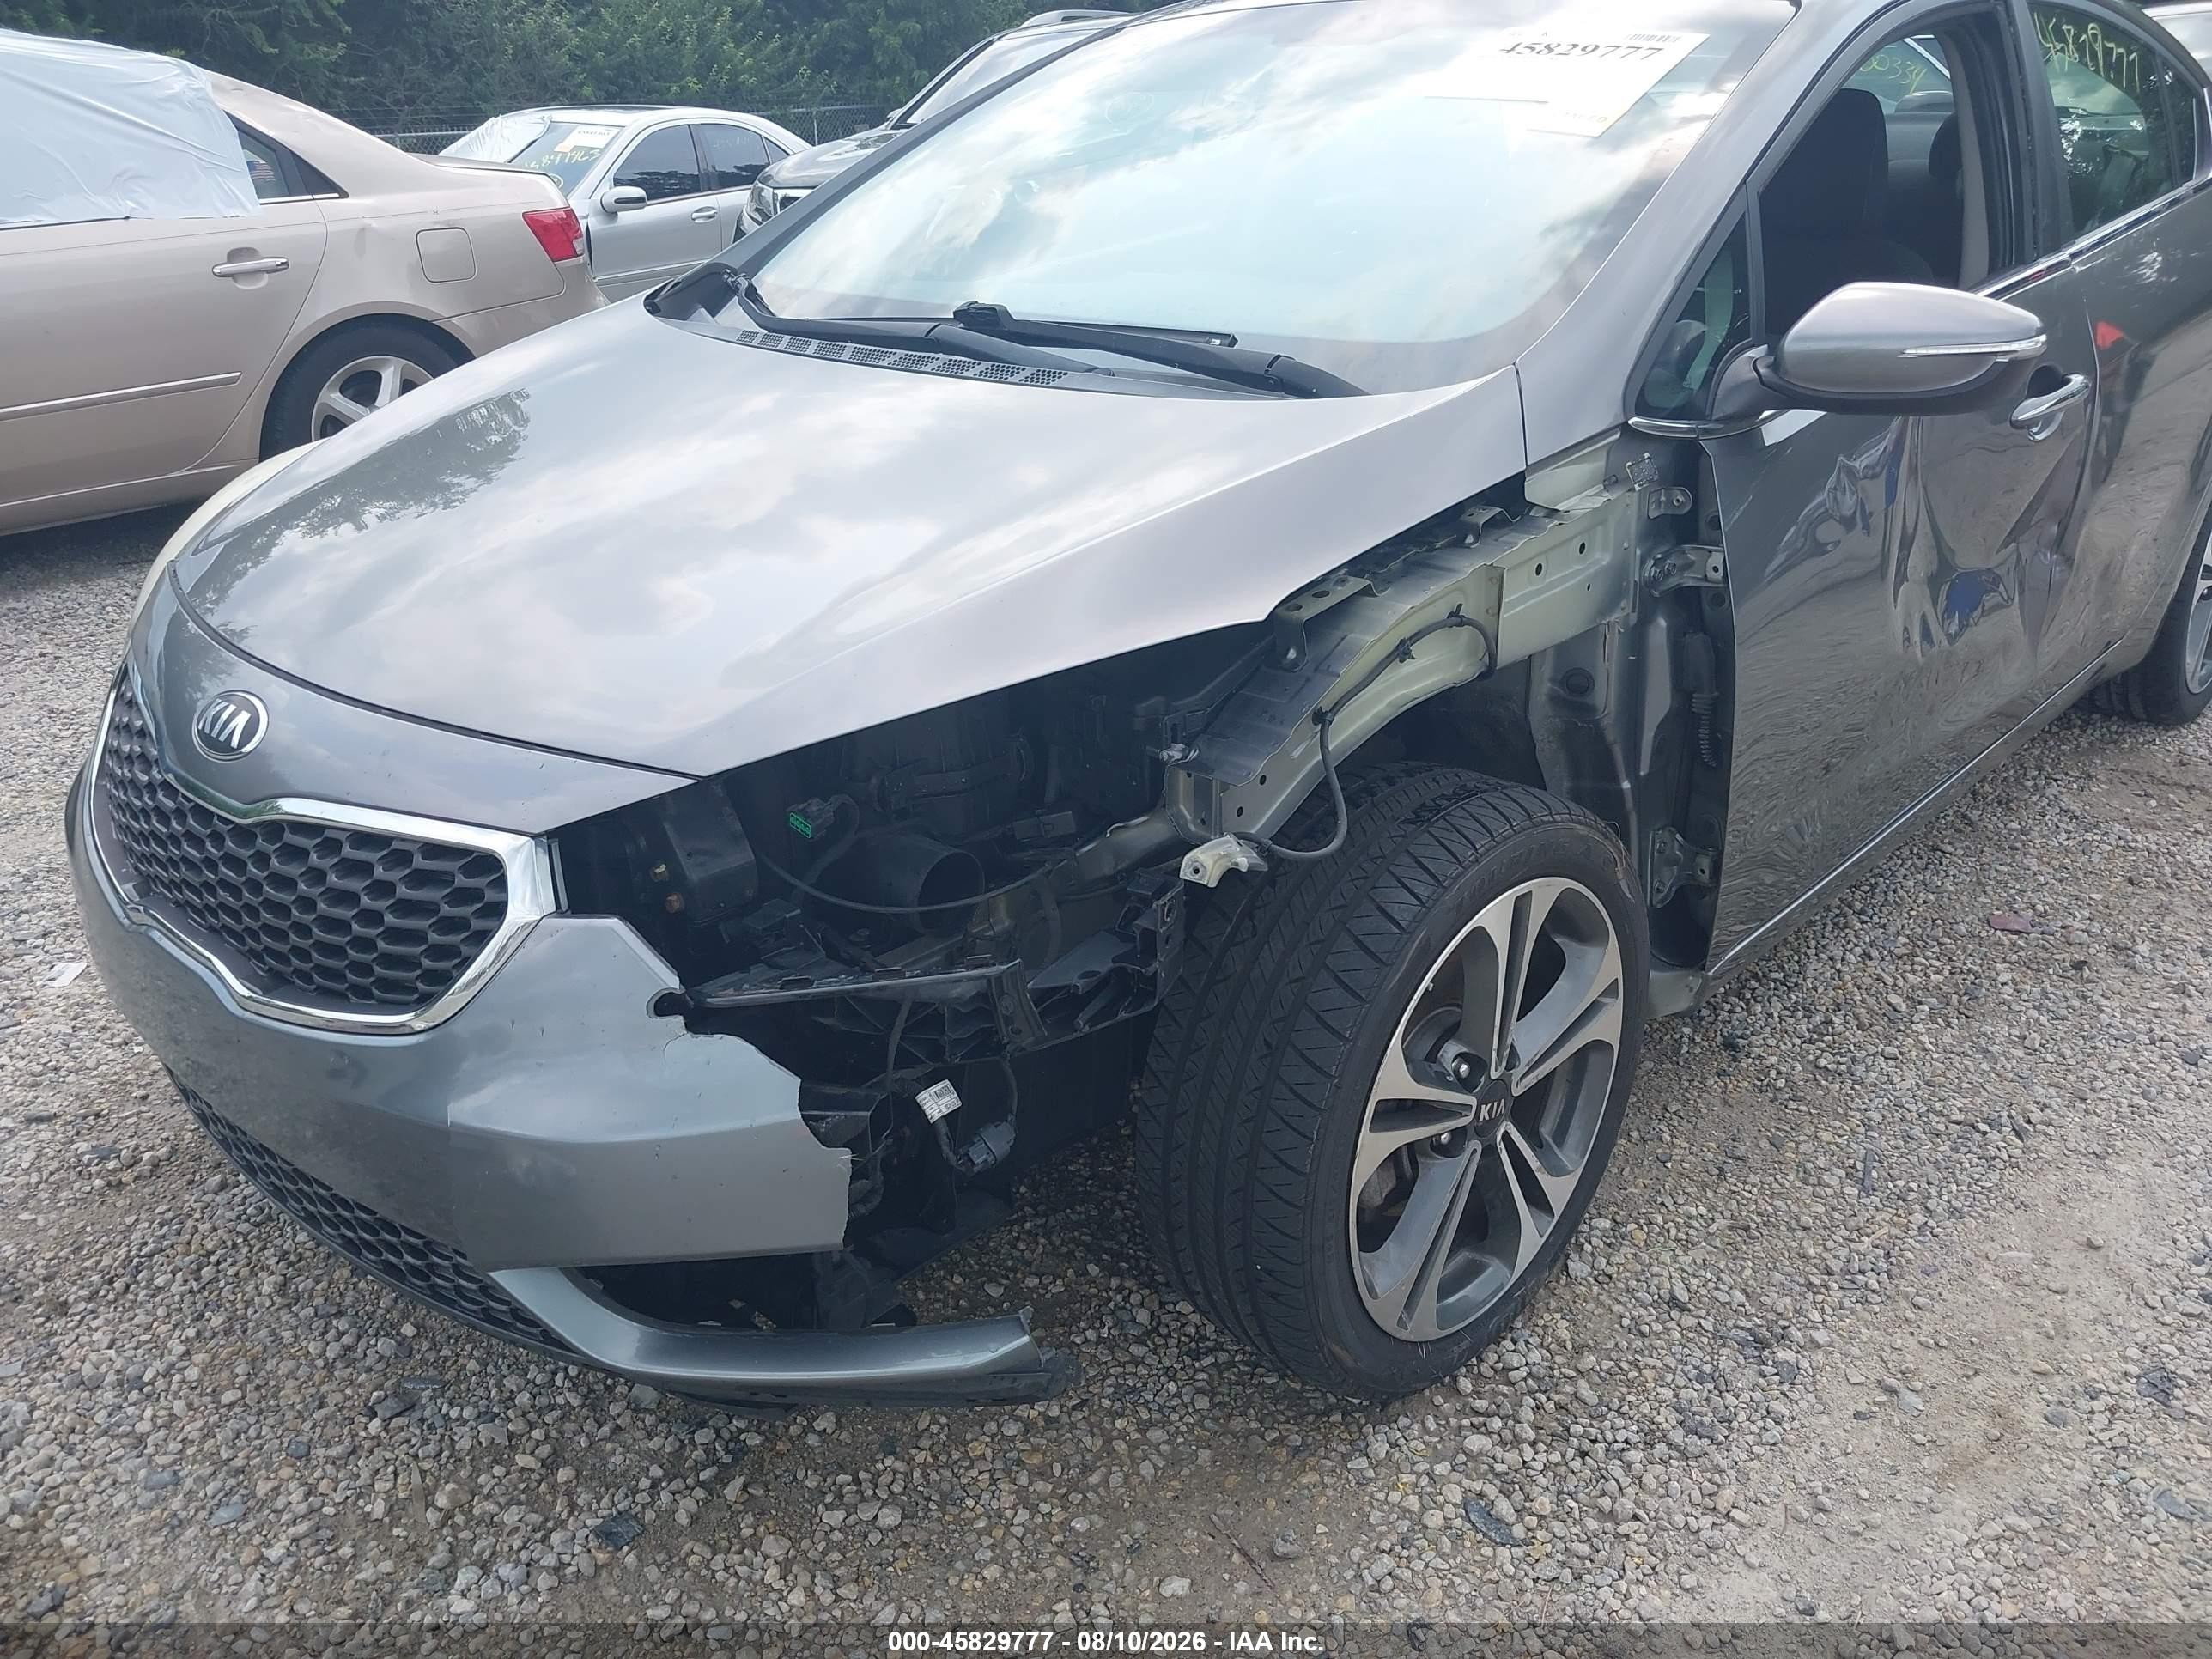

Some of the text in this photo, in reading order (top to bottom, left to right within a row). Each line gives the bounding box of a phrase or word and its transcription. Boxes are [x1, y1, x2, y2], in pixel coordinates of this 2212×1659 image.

[1498, 41, 1666, 61] 45829777
[198, 698, 251, 749] KIA
[1479, 1098, 1505, 1121] KIA
